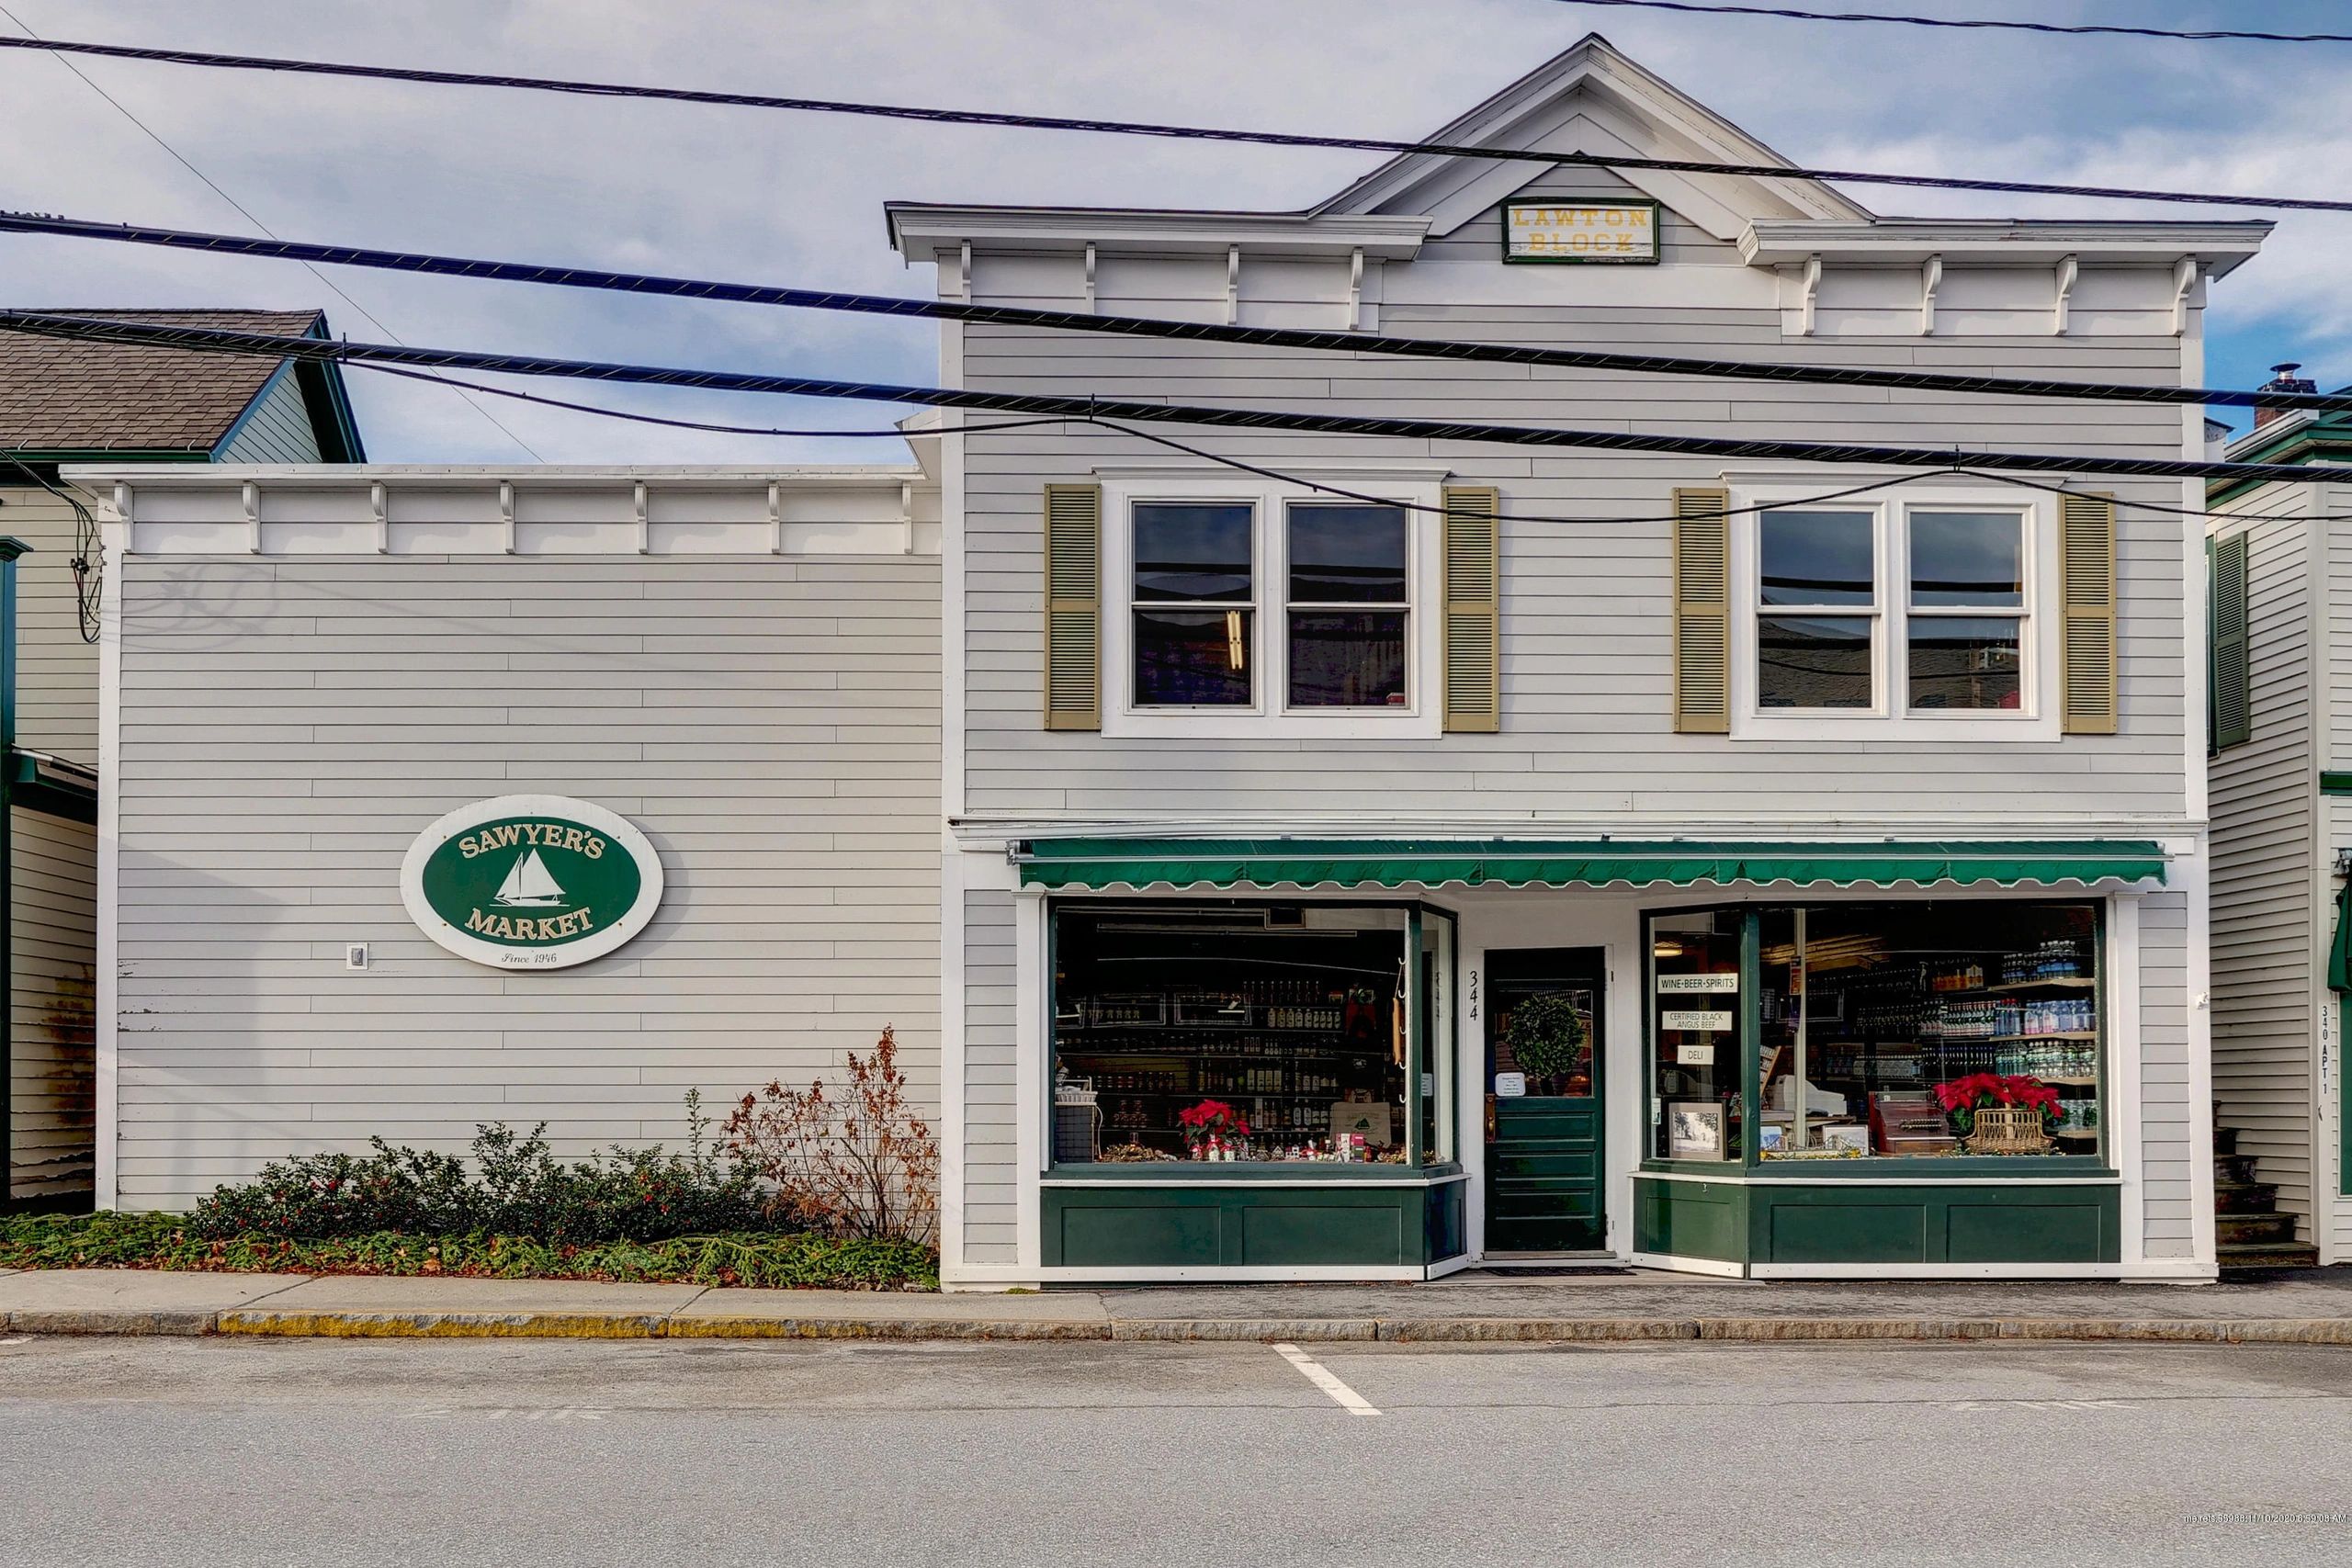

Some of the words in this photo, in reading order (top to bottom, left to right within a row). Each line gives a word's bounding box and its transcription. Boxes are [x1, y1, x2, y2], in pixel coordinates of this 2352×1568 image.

[1513, 209, 1647, 226] LAWTON
[1528, 232, 1633, 251] BLOCK
[458, 823, 606, 860] SAWYER'S
[464, 907, 594, 941] MARKET
[501, 953, 529, 964] Since
[1469, 970, 1478, 1021] 344
[1669, 1012, 1700, 1021] CERTIFIED
[1702, 1012, 1724, 1021] BLACK
[1677, 1021, 1700, 1029] ANGUS
[1701, 1021, 1715, 1029] BEEF
[1688, 1050, 1703, 1060] DELI
